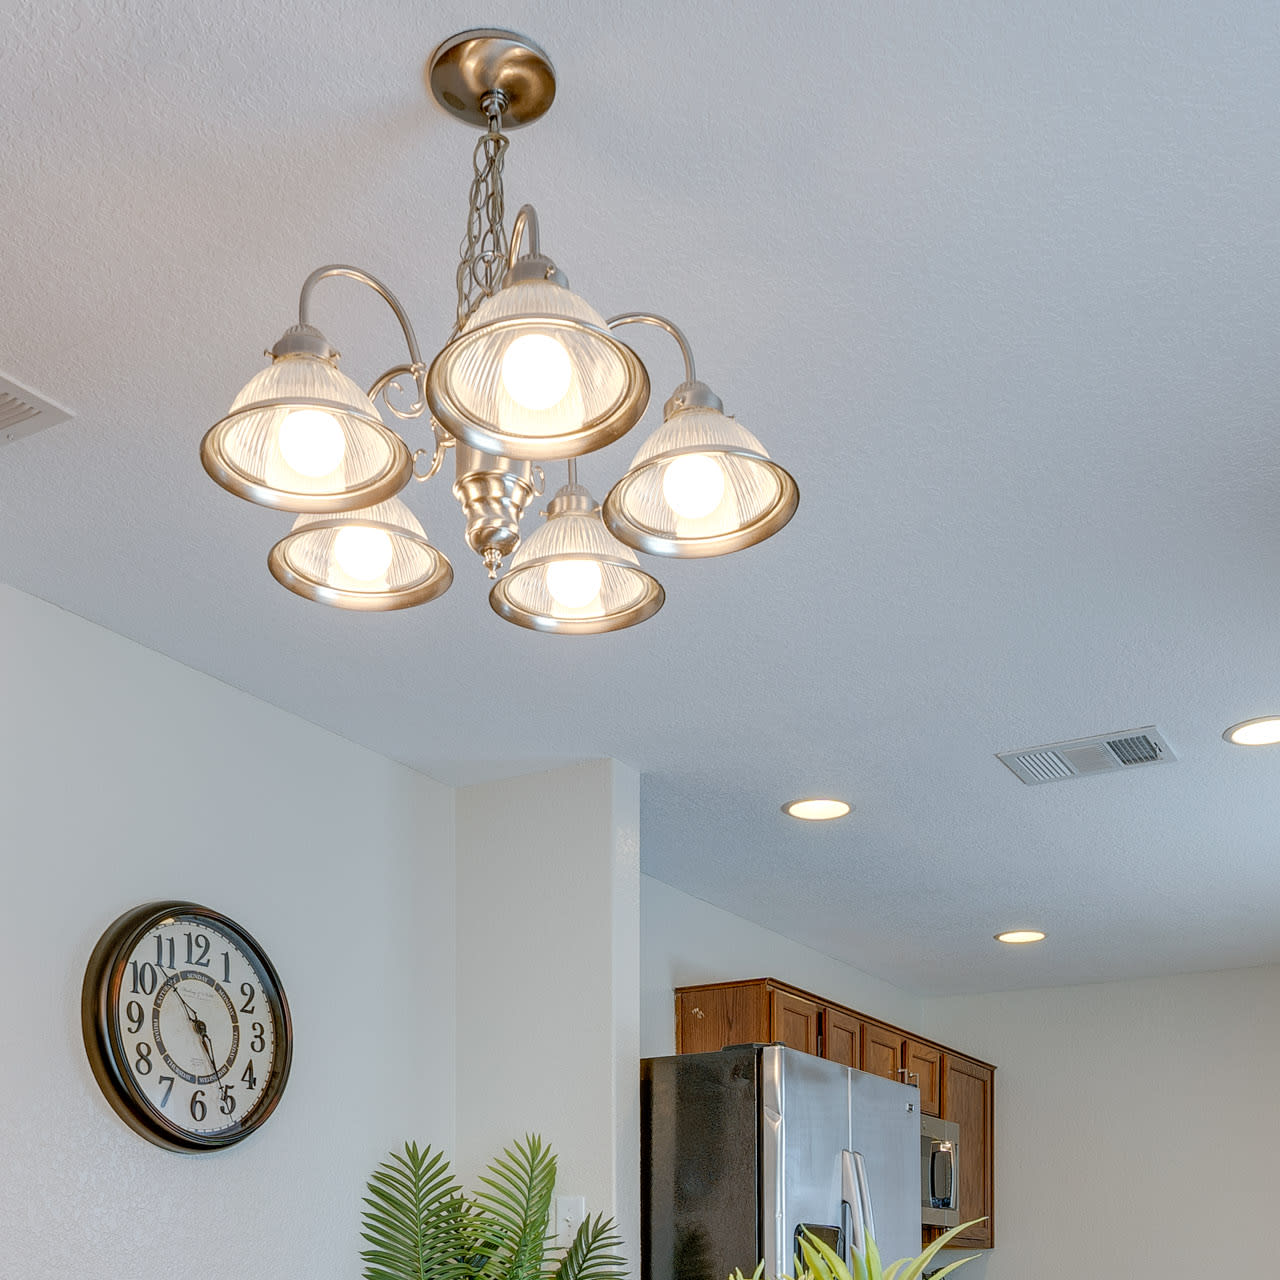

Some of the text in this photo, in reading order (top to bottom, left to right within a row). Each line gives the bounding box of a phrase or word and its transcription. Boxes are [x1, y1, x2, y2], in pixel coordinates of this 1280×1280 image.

[153, 933, 177, 970] 11
[184, 932, 211, 967] 12
[130, 960, 158, 996] 10
[221, 951, 233, 984] 1
[240, 982, 255, 1015] 2
[126, 1000, 145, 1034] 9
[250, 1022, 266, 1053] 3
[135, 1042, 153, 1076] 8
[241, 1059, 257, 1090] 4
[158, 1076, 175, 1108] 7
[190, 1090, 207, 1122] 6
[220, 1084, 236, 1115] 5
